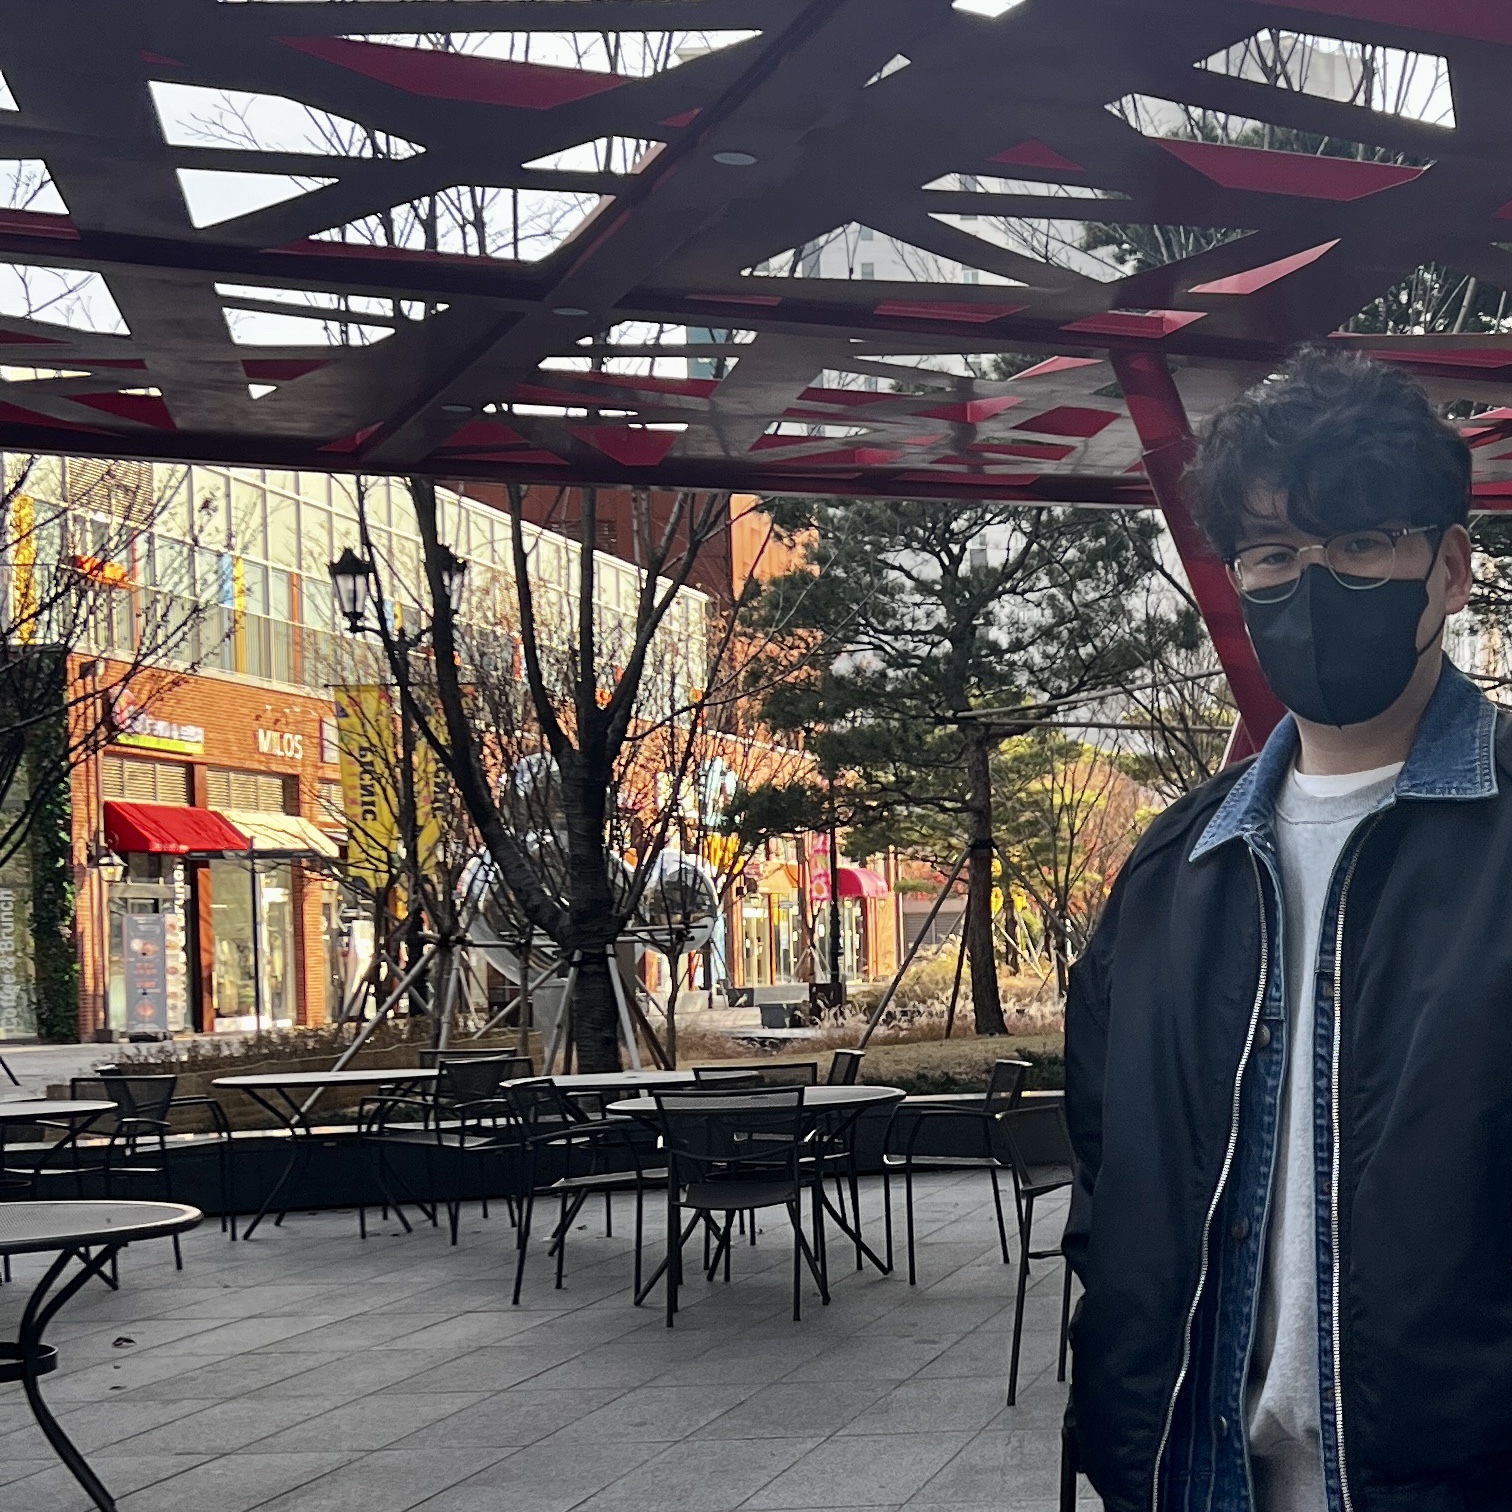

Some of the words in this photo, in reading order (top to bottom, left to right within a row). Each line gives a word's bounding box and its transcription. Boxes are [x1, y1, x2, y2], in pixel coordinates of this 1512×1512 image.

[258, 728, 304, 759] MILOS
[0, 889, 15, 951] Brunch
[0, 956, 15, 969] &
